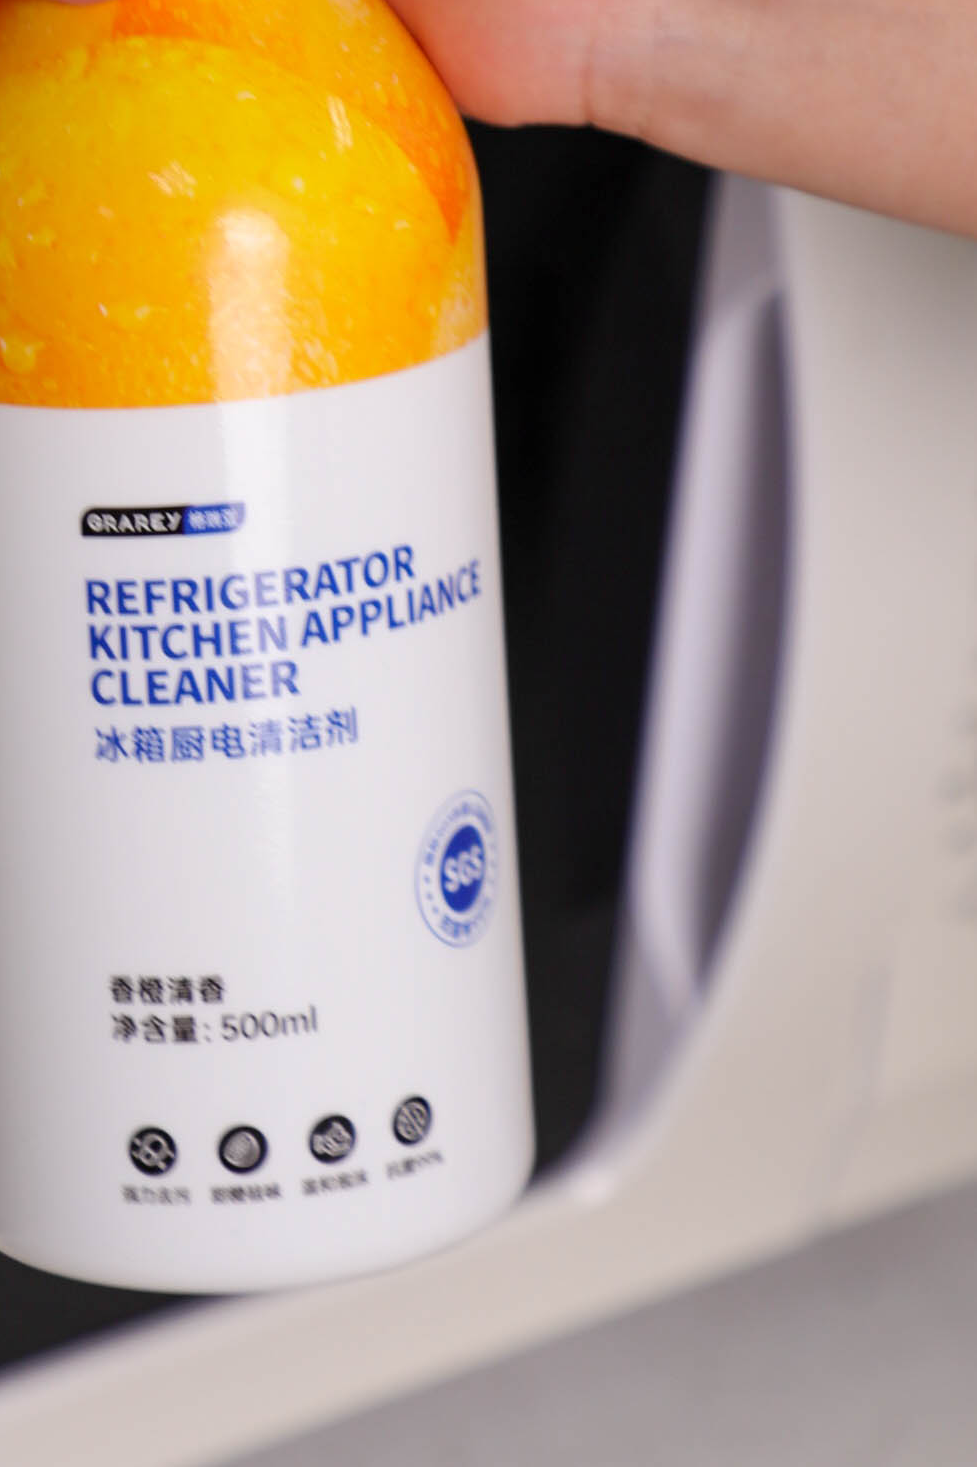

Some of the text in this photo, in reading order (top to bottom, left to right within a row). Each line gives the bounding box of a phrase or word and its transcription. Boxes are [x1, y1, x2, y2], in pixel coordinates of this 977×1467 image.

[85, 544, 414, 616] REFRIGERATOR
[88, 558, 482, 661] KITCHEN APPLIANCE
[90, 660, 301, 706] CLEANER
[95, 706, 358, 763] 冰箱厨电清洁剂
[443, 844, 481, 893] SGS
[109, 975, 224, 1004] 香橙清香
